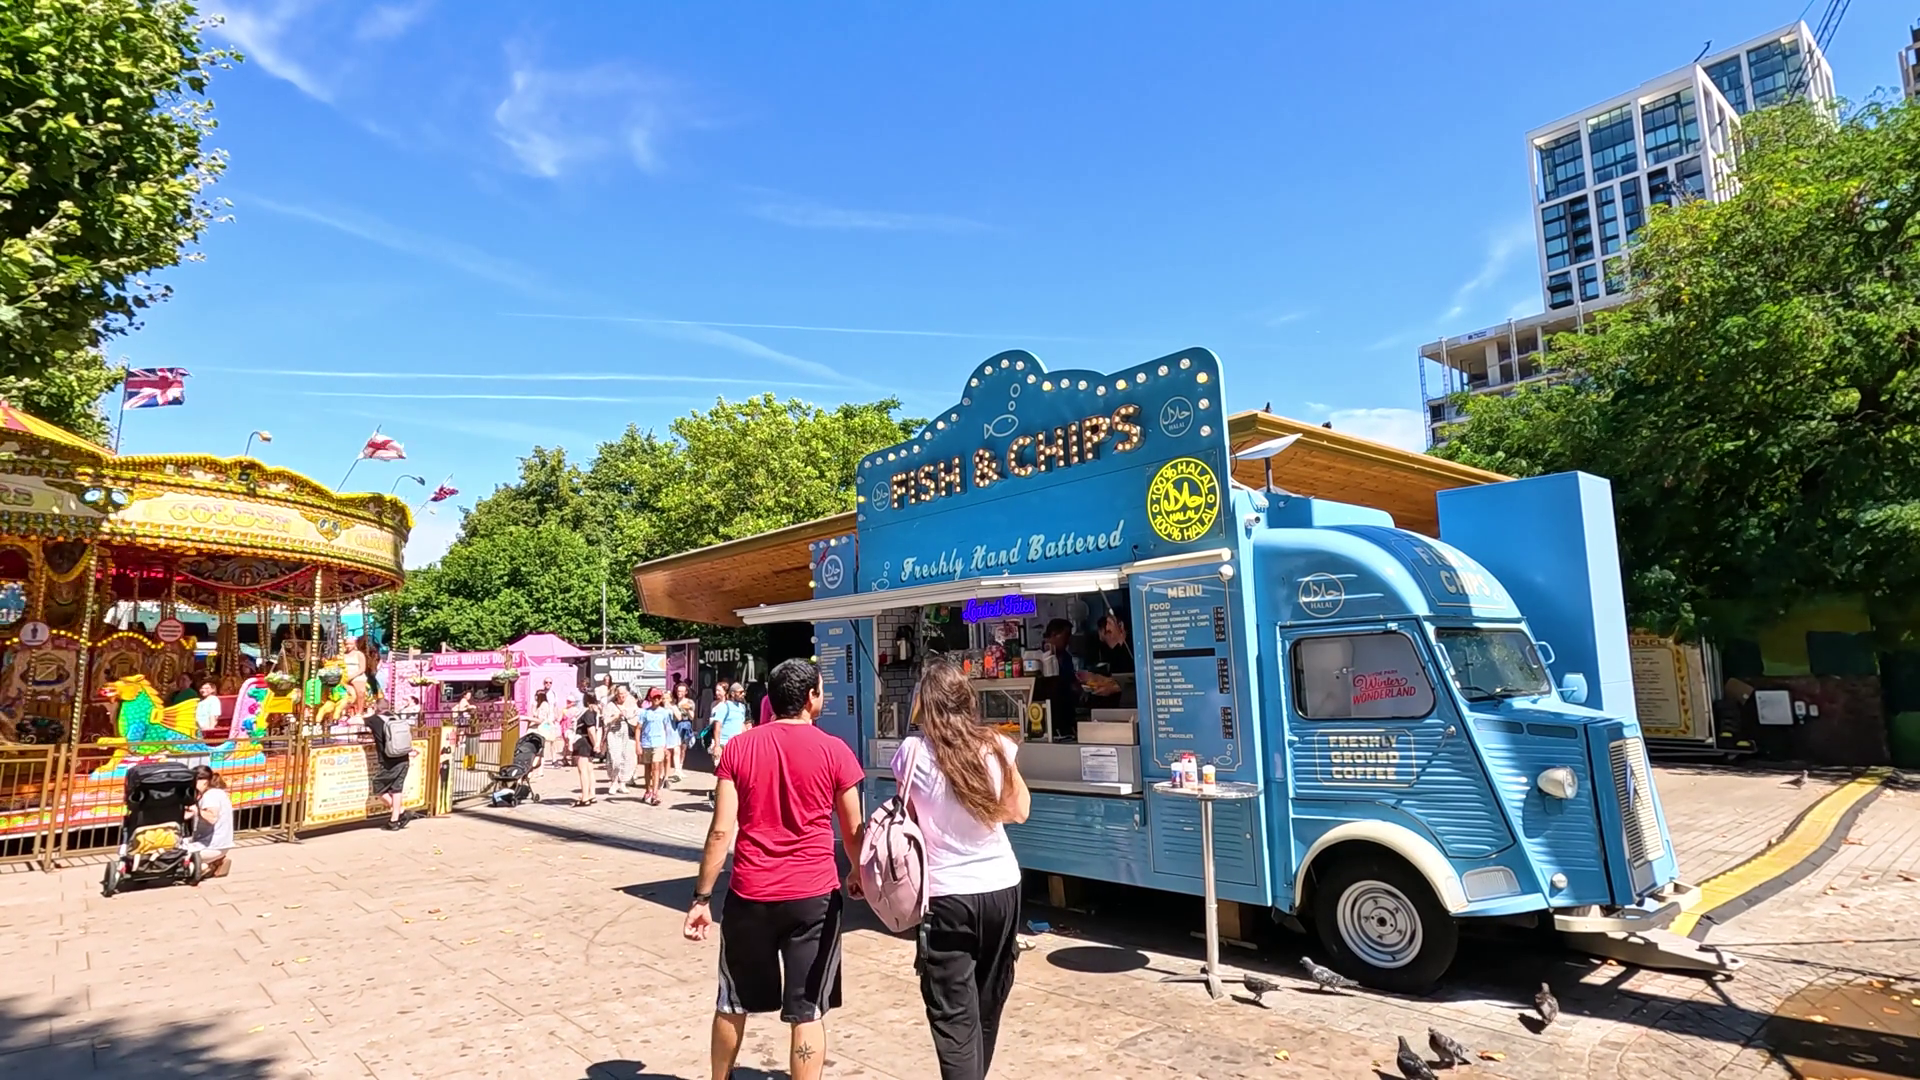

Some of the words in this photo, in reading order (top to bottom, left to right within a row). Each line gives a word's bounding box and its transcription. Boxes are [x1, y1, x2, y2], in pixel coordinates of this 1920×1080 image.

[890, 456, 963, 510] FISH
[973, 448, 1005, 489] &
[1006, 404, 1145, 477] CHIPS
[1152, 466, 1177, 501] 100%
[1177, 461, 1215, 494] HALAL
[1169, 509, 1200, 522] HALAL
[1154, 514, 1182, 541] 100%
[1183, 506, 1217, 540] HALAL
[900, 550, 965, 582] Freshly
[969, 538, 1022, 571] Hand
[1028, 520, 1125, 562] Battered
[1439, 569, 1491, 598] CHIPS
[1167, 584, 1202, 599] MENU
[1149, 602, 1171, 611] FOOD
[1310, 601, 1334, 609] HALAL
[435, 654, 459, 665] COFFEE
[461, 653, 490, 665] WAFFLES
[704, 648, 741, 662] TOILETS
[610, 656, 645, 670] WAFFLES
[1353, 674, 1408, 692] Winter
[1156, 697, 1183, 706] DRINKS
[1353, 686, 1417, 705] WONDERLAND
[1328, 735, 1397, 748] FRESHLY
[1331, 751, 1399, 764] GROUND
[1332, 766, 1397, 779] COFFEE
